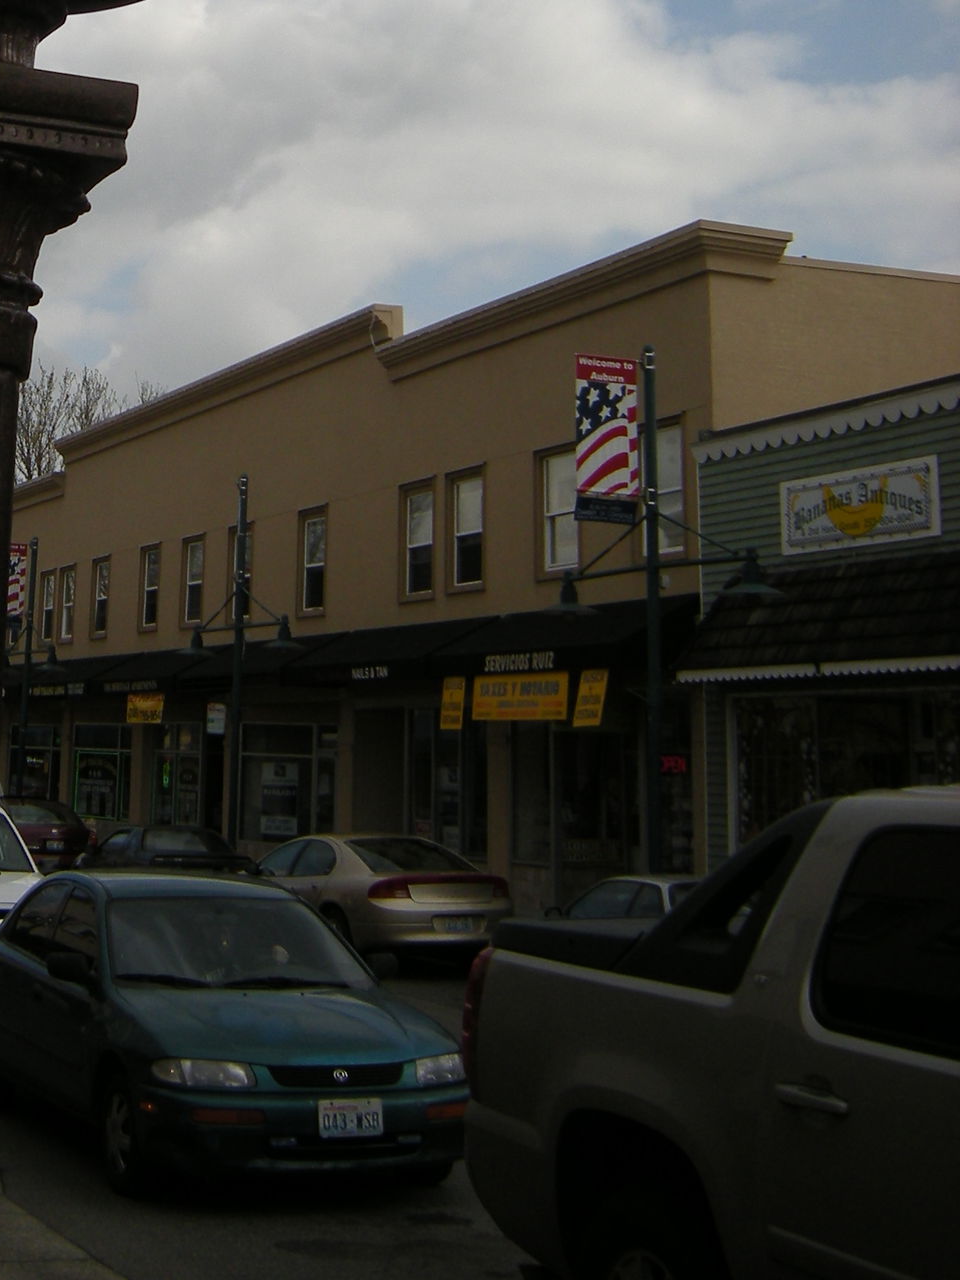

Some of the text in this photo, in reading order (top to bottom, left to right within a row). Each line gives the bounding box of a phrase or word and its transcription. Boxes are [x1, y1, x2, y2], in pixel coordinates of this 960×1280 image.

[579, 357, 634, 370] Welcome to
[590, 372, 625, 383] Auburn
[858, 482, 922, 515] Antiques
[484, 651, 555, 672] SERVICIOS RUIZ
